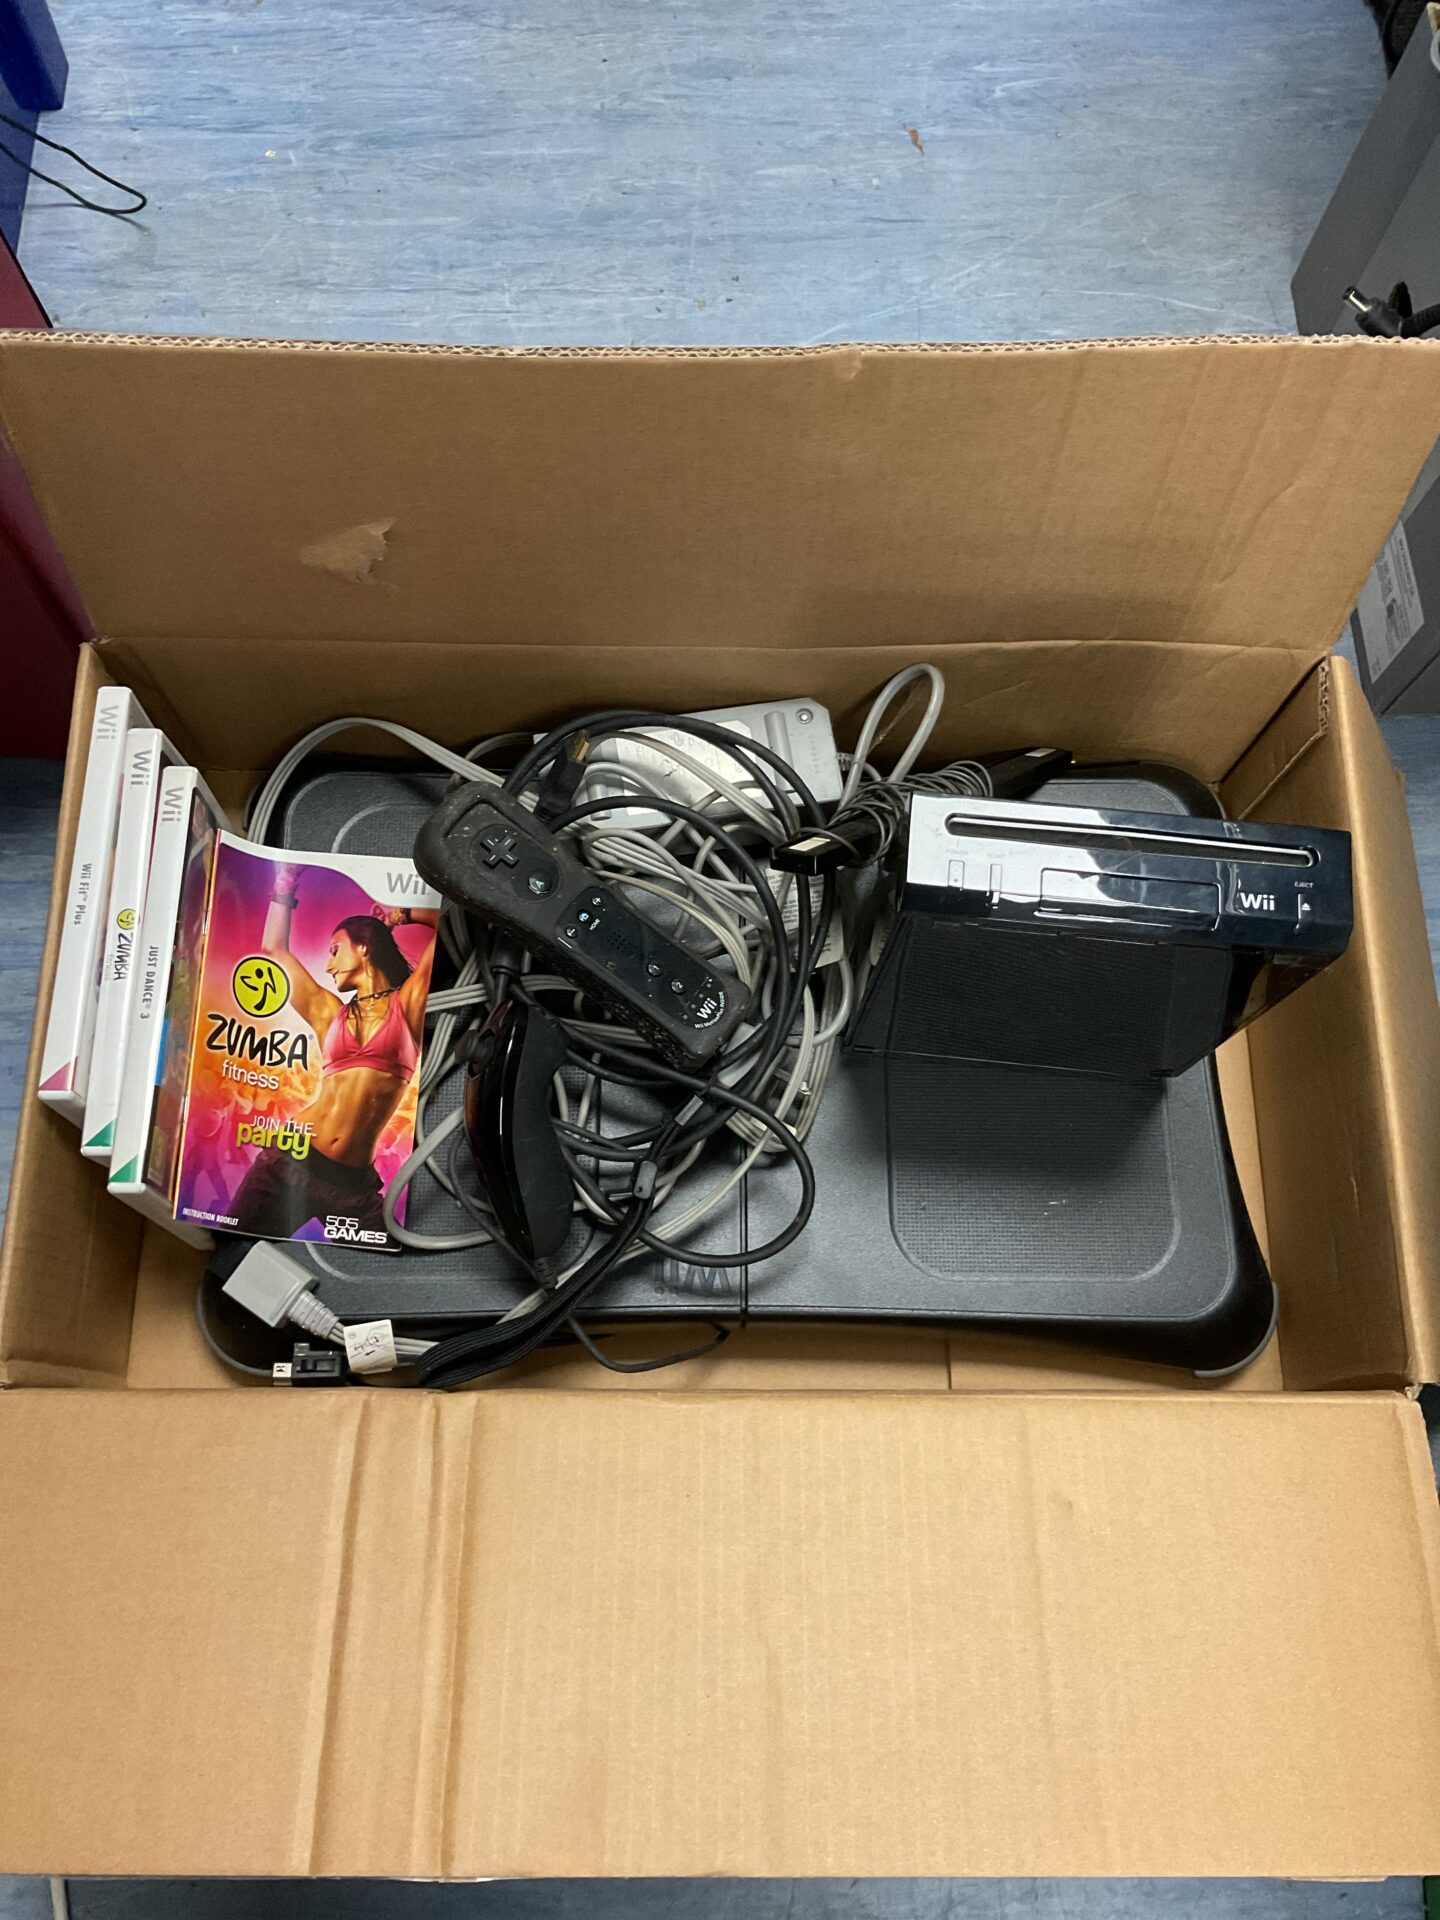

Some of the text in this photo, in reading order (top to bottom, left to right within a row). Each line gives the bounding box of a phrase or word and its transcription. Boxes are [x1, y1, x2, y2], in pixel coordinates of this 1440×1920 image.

[96, 706, 119, 739] Wii
[130, 750, 153, 785] Wii
[162, 787, 184, 822] Wii
[80, 863, 92, 879] Wii
[387, 872, 426, 895] Wii
[1294, 881, 1314, 889] EJECT
[1240, 892, 1275, 911] Wii
[74, 904, 86, 925] Plus
[113, 932, 134, 980] ZUMBA
[147, 945, 159, 967] JUST
[696, 998, 718, 1019] Wii
[206, 1013, 309, 1071] ZUMBA
[222, 1060, 280, 1090] fitness
[250, 1115, 317, 1137] JOIN THE
[236, 1122, 312, 1161] party
[182, 1207, 239, 1226] INSTRUCTION BOOKLET
[323, 1227, 387, 1244] GAMES
